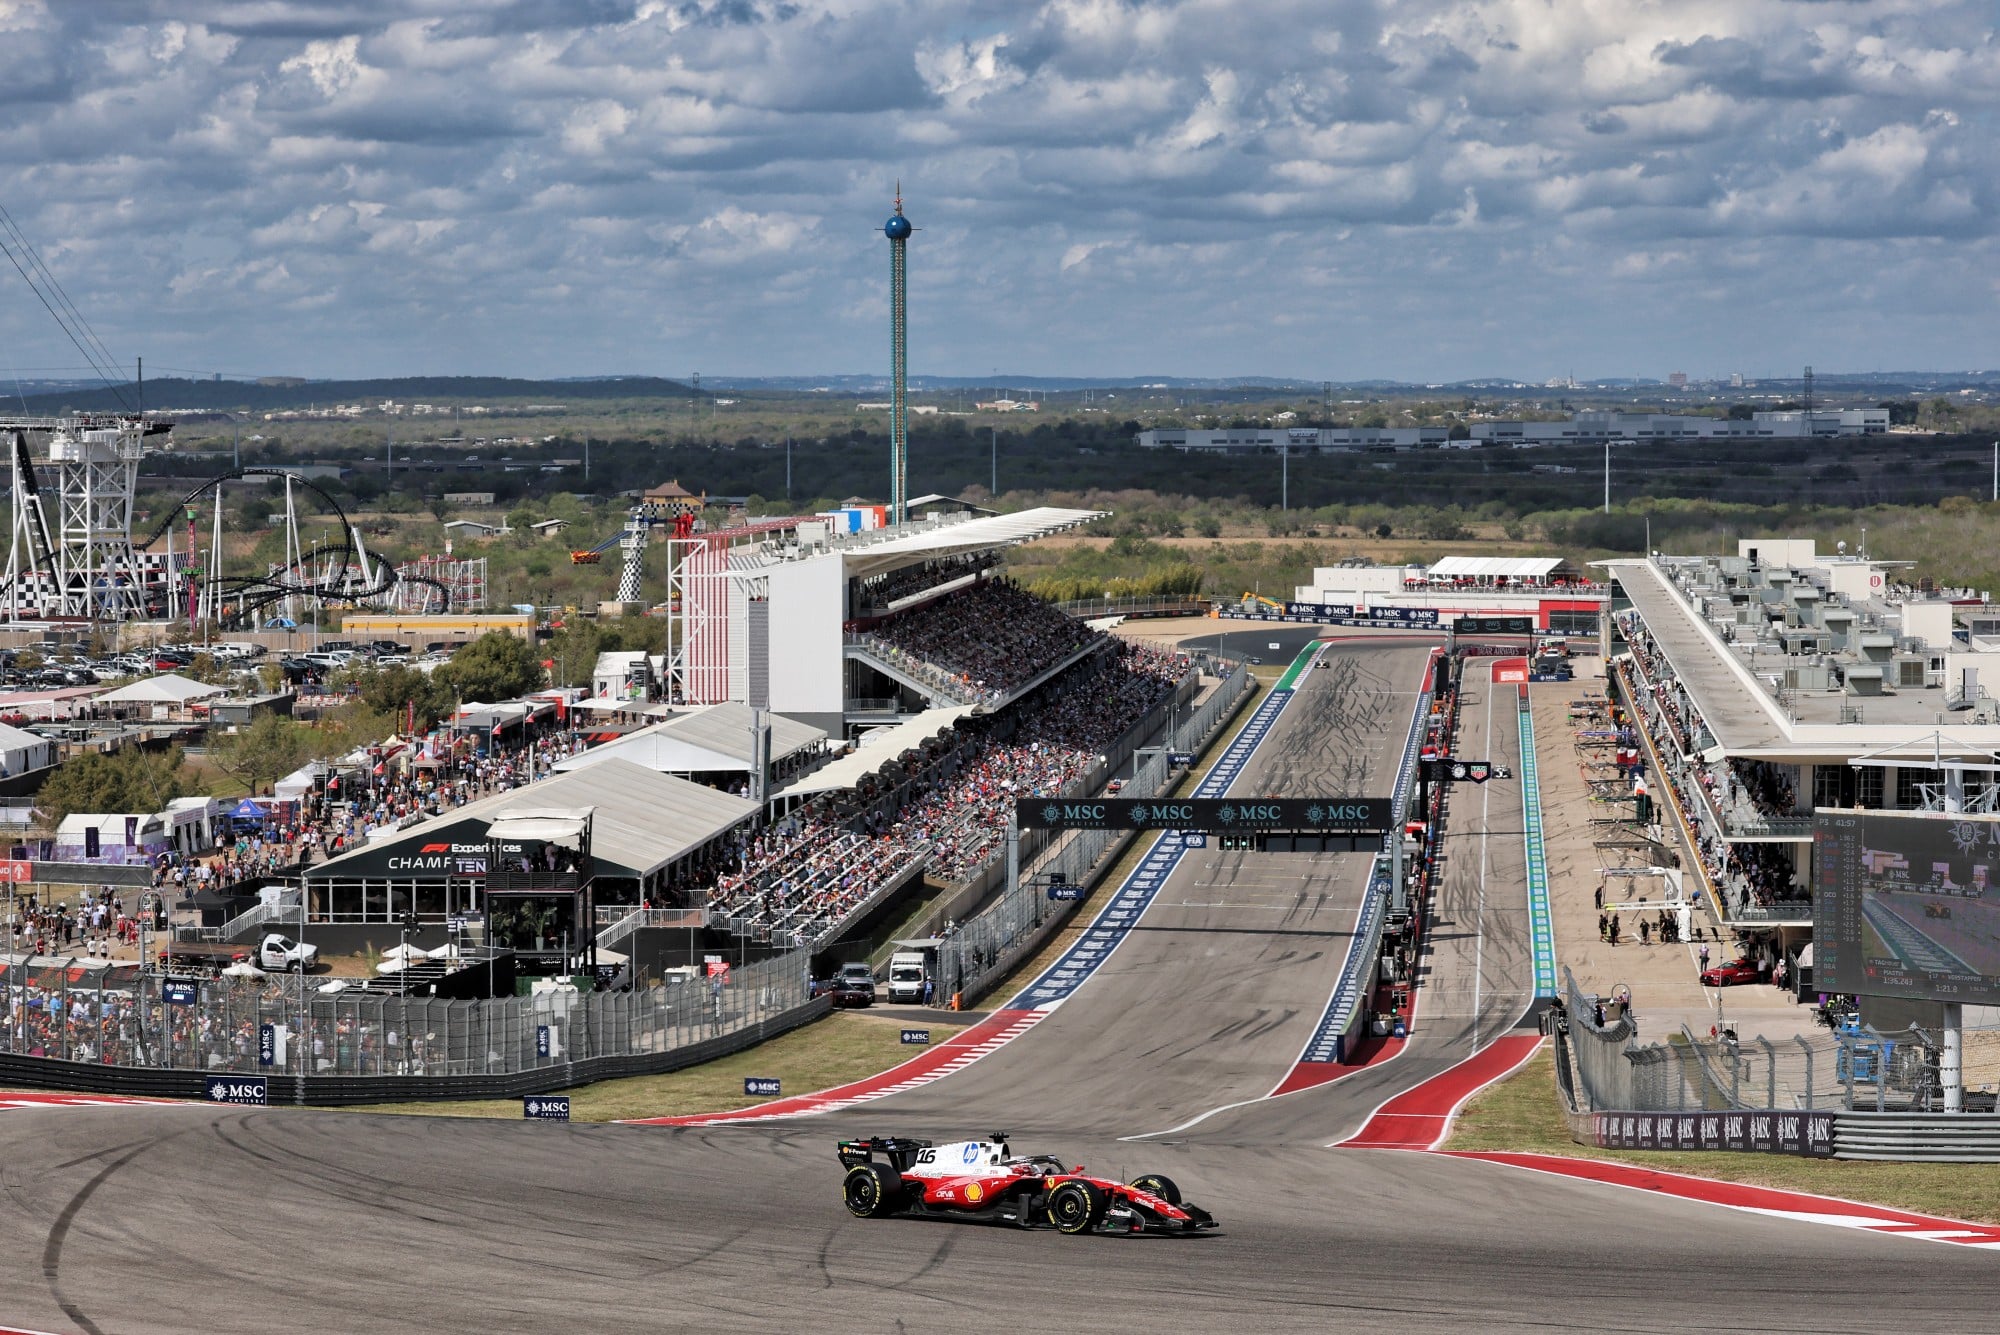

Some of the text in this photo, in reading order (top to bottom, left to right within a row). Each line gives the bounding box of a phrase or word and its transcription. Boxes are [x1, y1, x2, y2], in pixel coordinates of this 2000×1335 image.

[1064, 805, 1105, 819] MSC
[1152, 805, 1193, 819] MSC
[1239, 805, 1281, 819] MSC
[1328, 805, 1369, 819] MSC
[452, 843, 522, 853] Experices
[455, 861, 487, 873] TEN
[174, 983, 194, 991] MSC
[262, 1029, 271, 1049] MSC
[228, 1085, 264, 1097] MSC
[758, 1082, 780, 1091] MSC
[541, 1102, 568, 1112] MSC
[1682, 1118, 1695, 1138] MSC
[1706, 1117, 1719, 1138] MSC
[1730, 1116, 1743, 1138] MSC
[1756, 1117, 1771, 1138] MSC
[1784, 1117, 1799, 1139] MSC
[1814, 1118, 1830, 1141] MSC
[916, 1149, 936, 1164] 16
